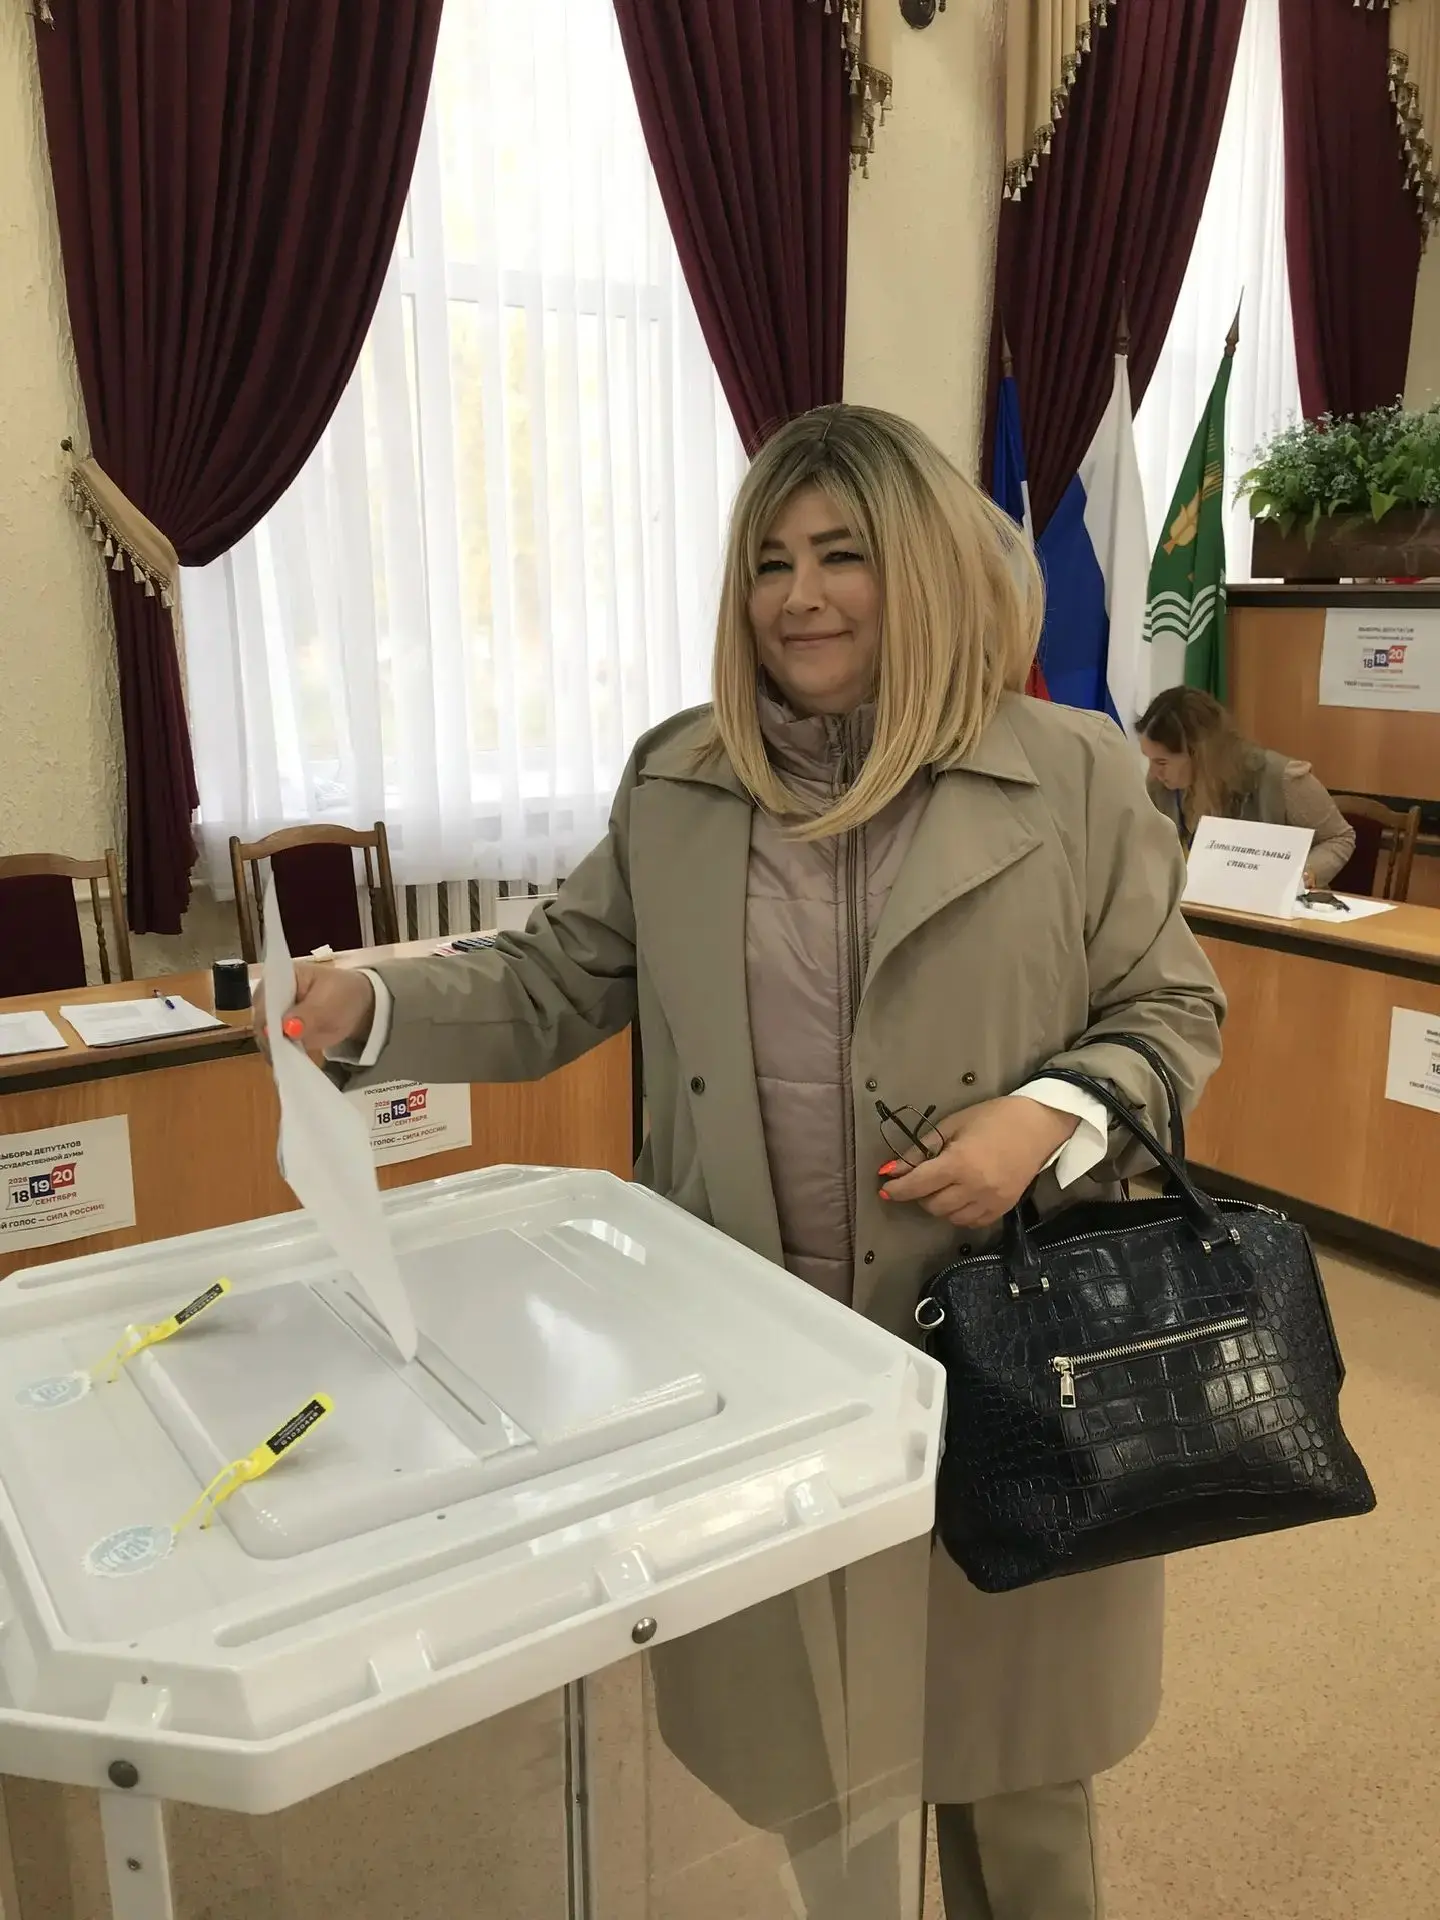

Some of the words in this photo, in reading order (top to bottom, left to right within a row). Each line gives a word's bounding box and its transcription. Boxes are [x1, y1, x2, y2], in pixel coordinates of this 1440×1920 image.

[1363, 658, 1373, 668] 18
[1376, 654, 1386, 664] 19
[1389, 649, 1403, 660] 20
[1205, 840, 1292, 860] Дополнительный
[1226, 859, 1259, 870] список
[376, 1112, 390, 1124] 18
[392, 1104, 406, 1116] 19
[410, 1094, 424, 1107] 20
[373, 1136, 396, 1146] ГОЛОС
[402, 1132, 420, 1140] СИЛА
[0, 1150, 32, 1160] ЫБОРЫ
[34, 1140, 82, 1156] ДЕПУТАТОВ
[0, 1154, 62, 1170] ОСУДАРСТВЕННОЙ
[64, 1150, 84, 1159] ДУМЫ
[12, 1190, 30, 1204] 18
[32, 1180, 50, 1194] 19
[53, 1169, 73, 1184] 20
[36, 1192, 77, 1206] СЕНТЯБРЯ
[9, 1218, 36, 1228] ГОЛОС
[46, 1212, 68, 1222] СИЛА
